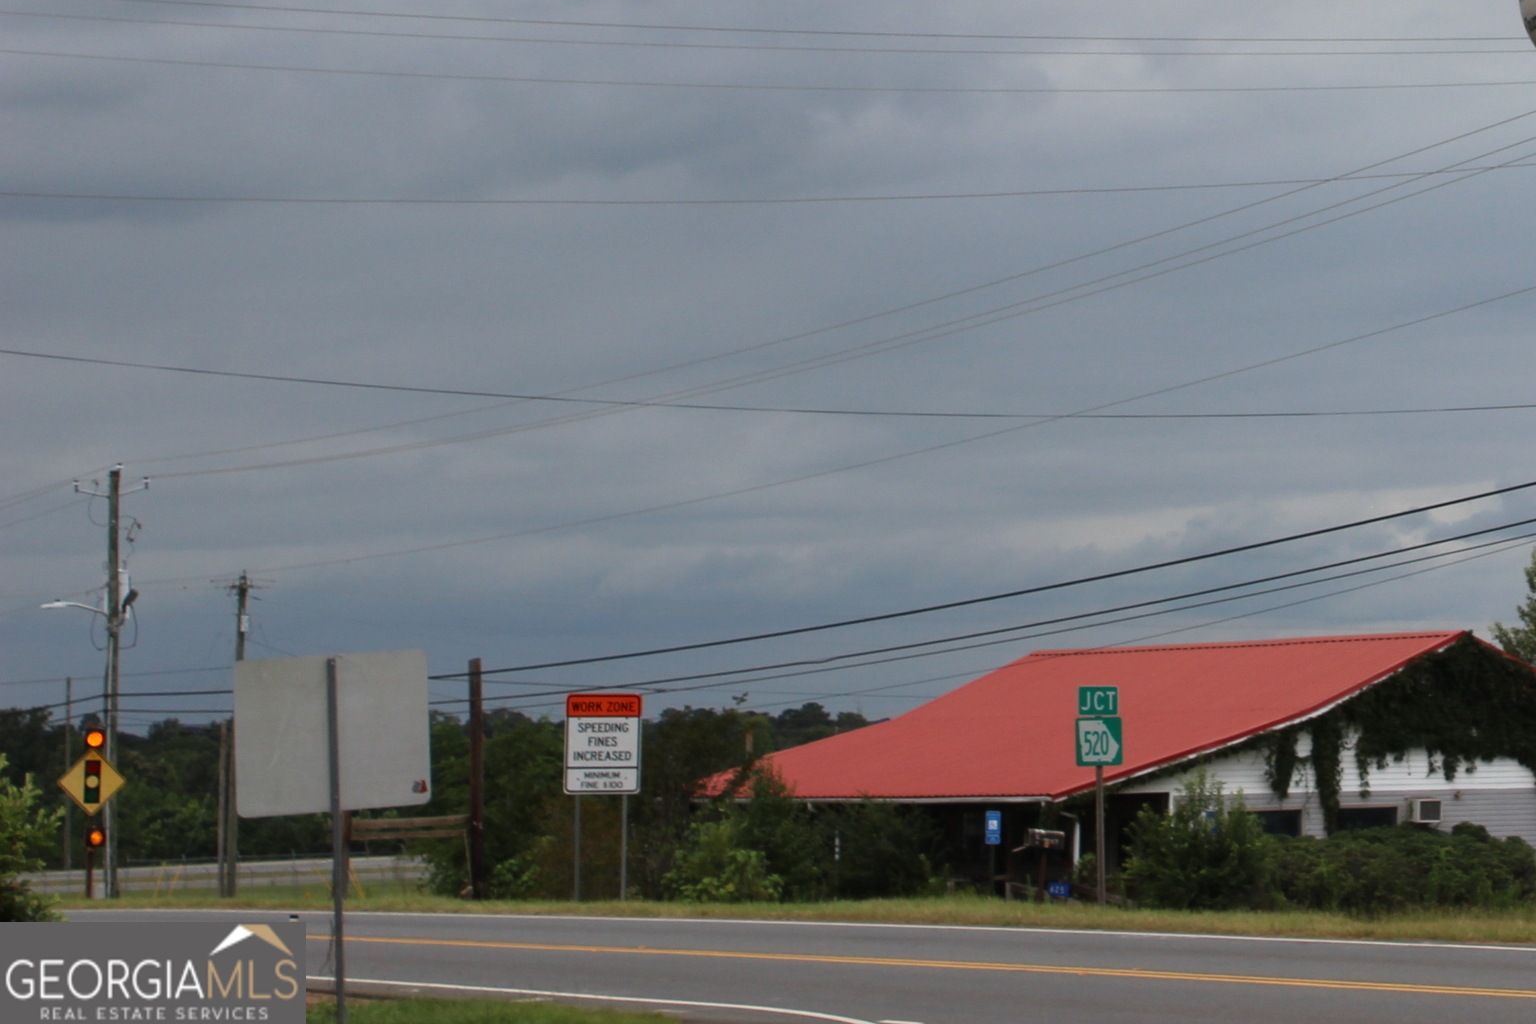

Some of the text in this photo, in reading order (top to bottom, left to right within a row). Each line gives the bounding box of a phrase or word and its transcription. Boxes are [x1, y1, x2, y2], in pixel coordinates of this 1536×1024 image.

[571, 701, 636, 712] WORK ZONE
[1081, 691, 1116, 711] JCT
[577, 722, 630, 733] SPEEDING
[587, 736, 618, 747] FINES
[1084, 730, 1109, 756] 520
[572, 751, 632, 761] INCREASED
[583, 771, 621, 779] MINIMUM
[580, 781, 623, 789] FINE $100
